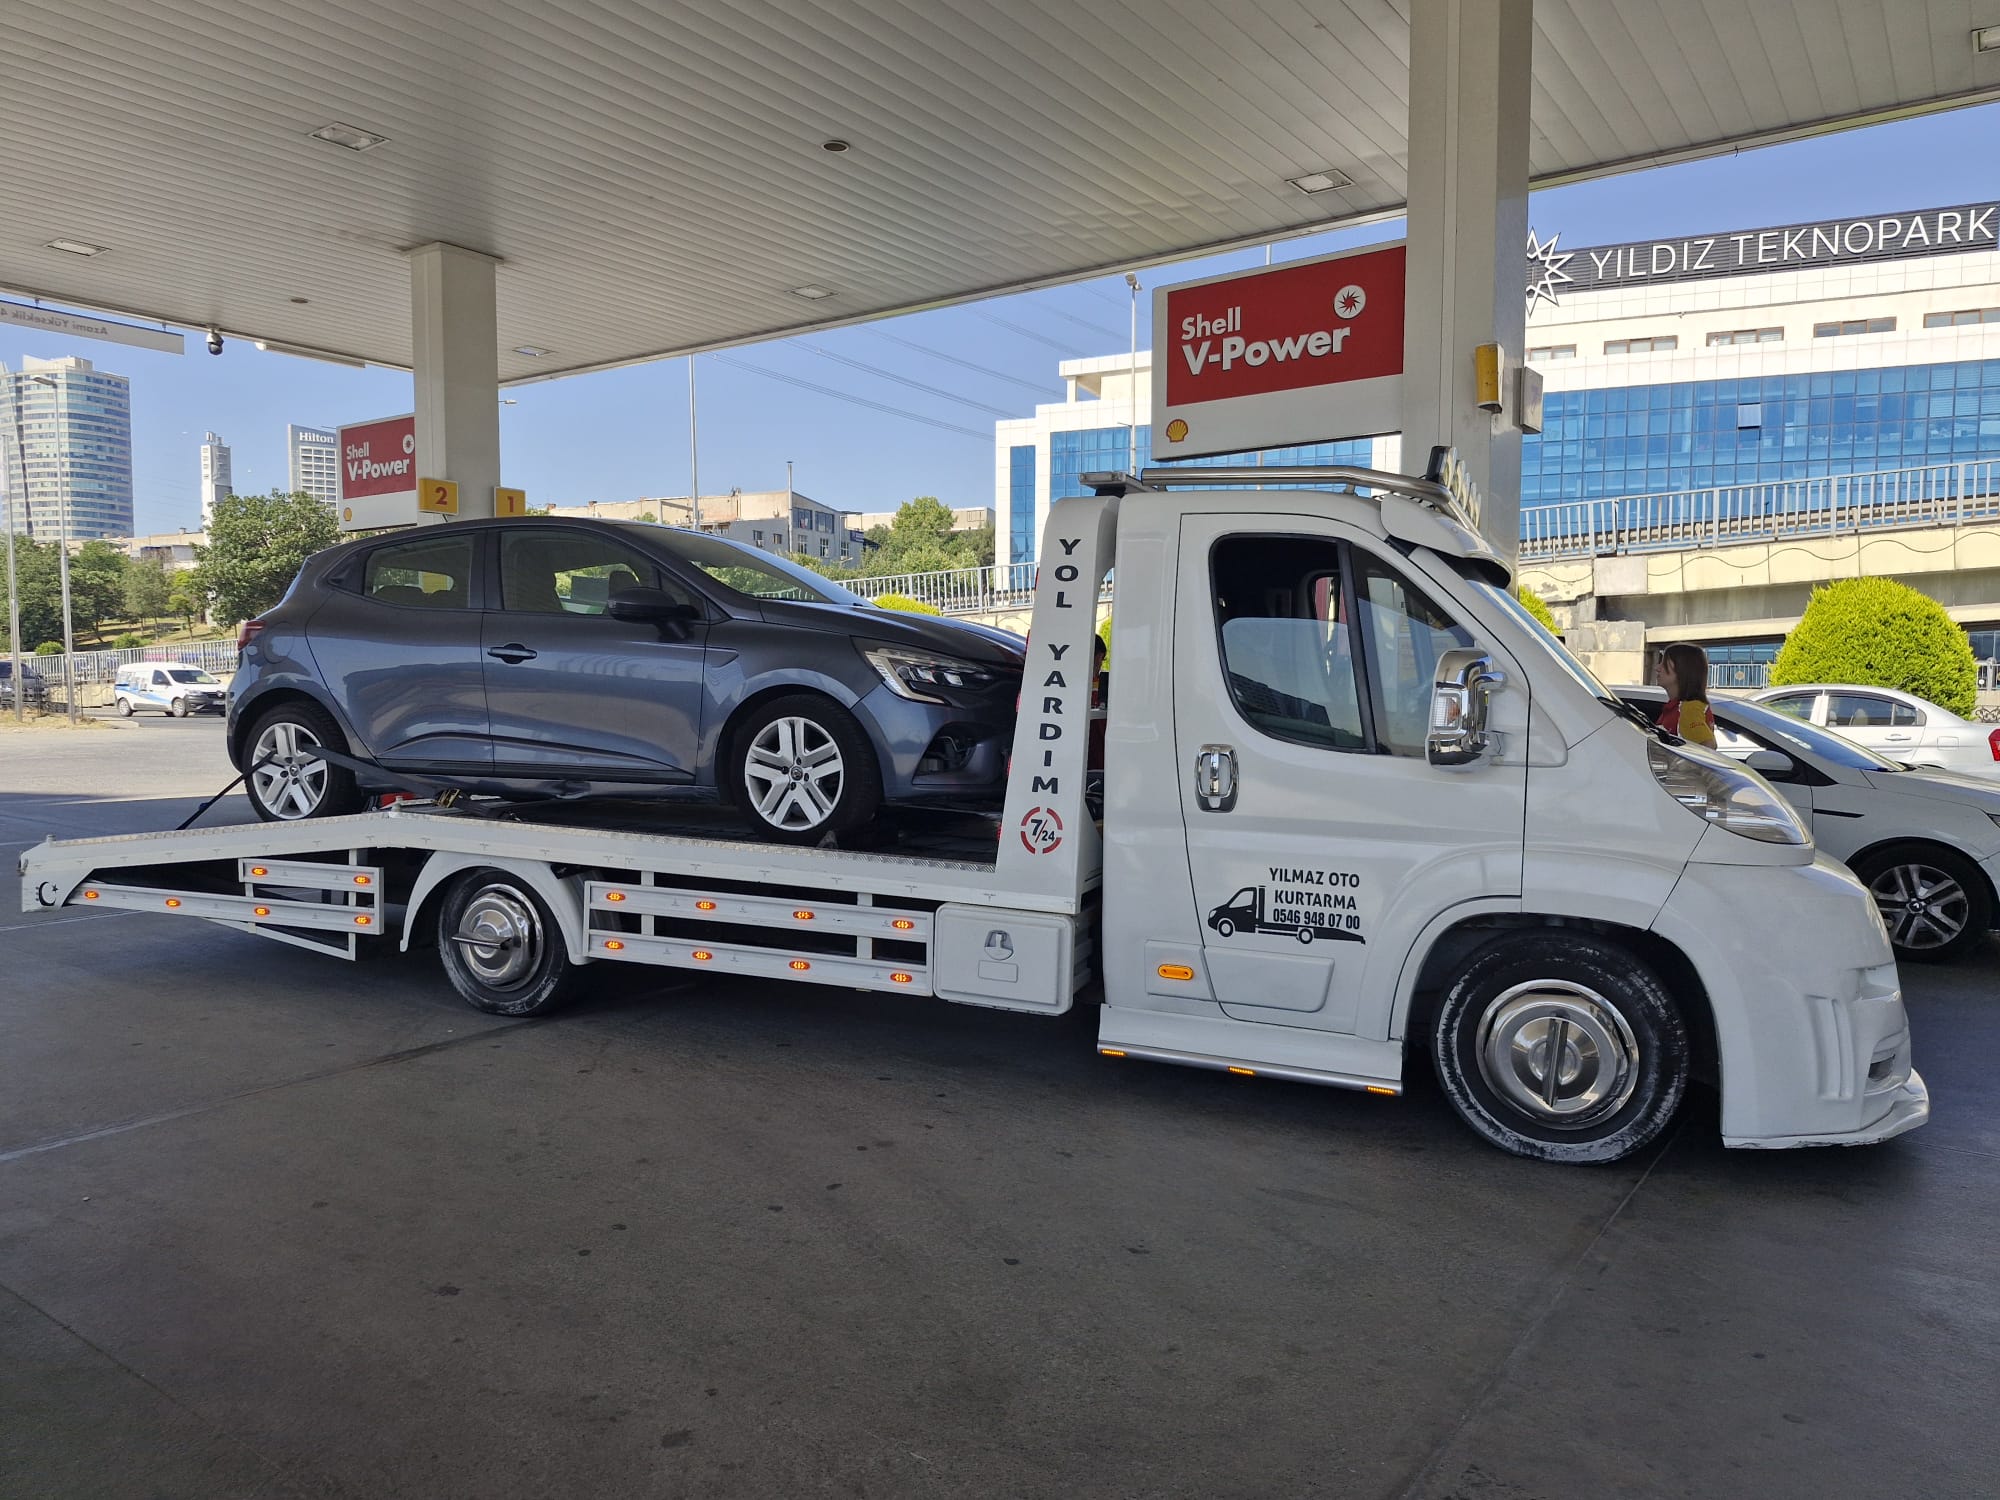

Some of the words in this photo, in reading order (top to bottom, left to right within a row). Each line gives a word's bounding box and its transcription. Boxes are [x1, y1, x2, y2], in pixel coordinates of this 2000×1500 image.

[1590, 239, 1715, 281] YILDIZ
[1730, 206, 1996, 265] TEKNOPARK
[1181, 306, 1241, 341] Shell
[1181, 326, 1351, 376] V-Power
[299, 431, 334, 444] Hilton
[346, 441, 370, 460] Shell
[347, 458, 410, 482] V-Power
[435, 486, 448, 506] 2
[506, 496, 515, 513] 1
[1054, 538, 1082, 609] YOL
[1031, 643, 1070, 795] YARDIM
[1269, 867, 1325, 885] YILMAZ
[1328, 872, 1360, 888] OTO
[1274, 889, 1357, 910] KURTARMA
[1273, 908, 1301, 924] 0546
[1304, 911, 1325, 926] 948
[1328, 913, 1343, 928] 07
[1345, 915, 1360, 930] 00
